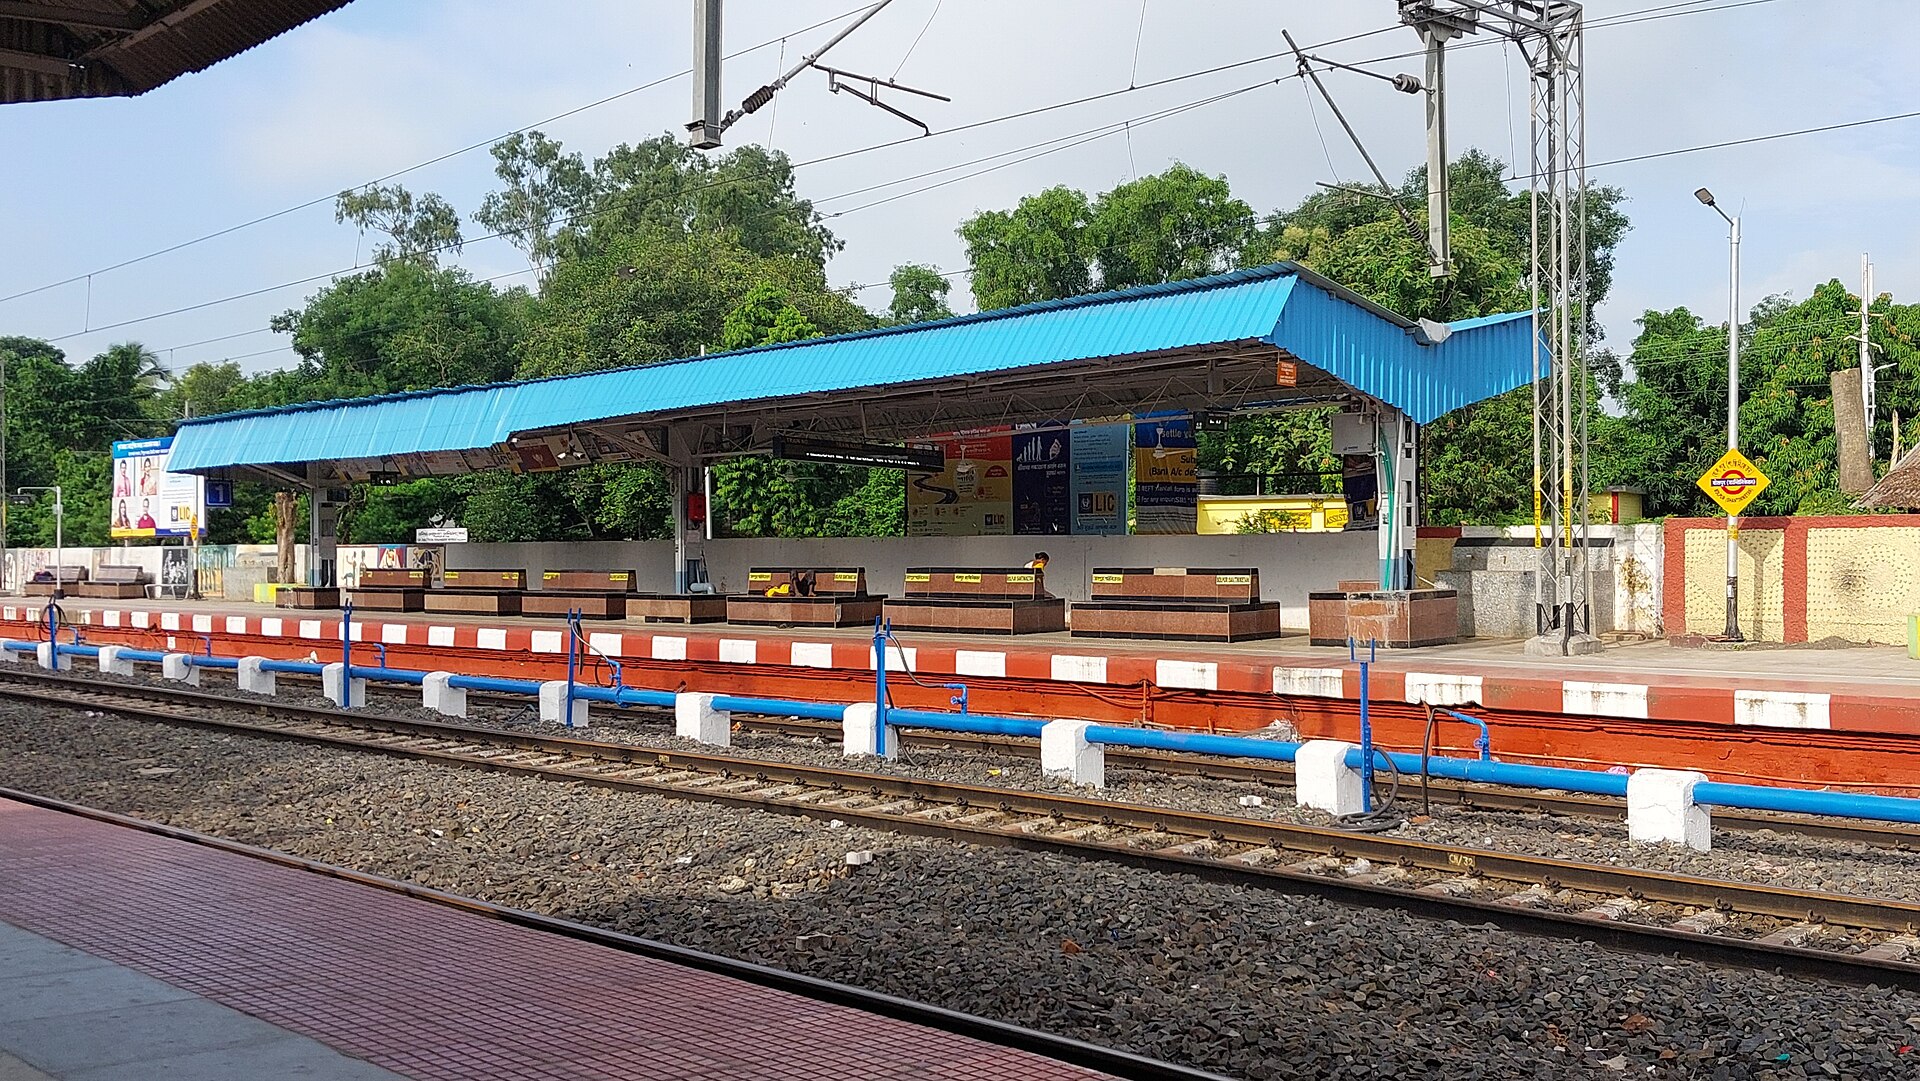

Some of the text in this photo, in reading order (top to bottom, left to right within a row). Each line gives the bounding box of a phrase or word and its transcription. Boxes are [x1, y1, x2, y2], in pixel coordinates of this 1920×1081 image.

[215, 484, 224, 502] 1
[1095, 494, 1115, 512] LIC
[179, 506, 190, 520] LIC
[993, 514, 1005, 525] LIC
